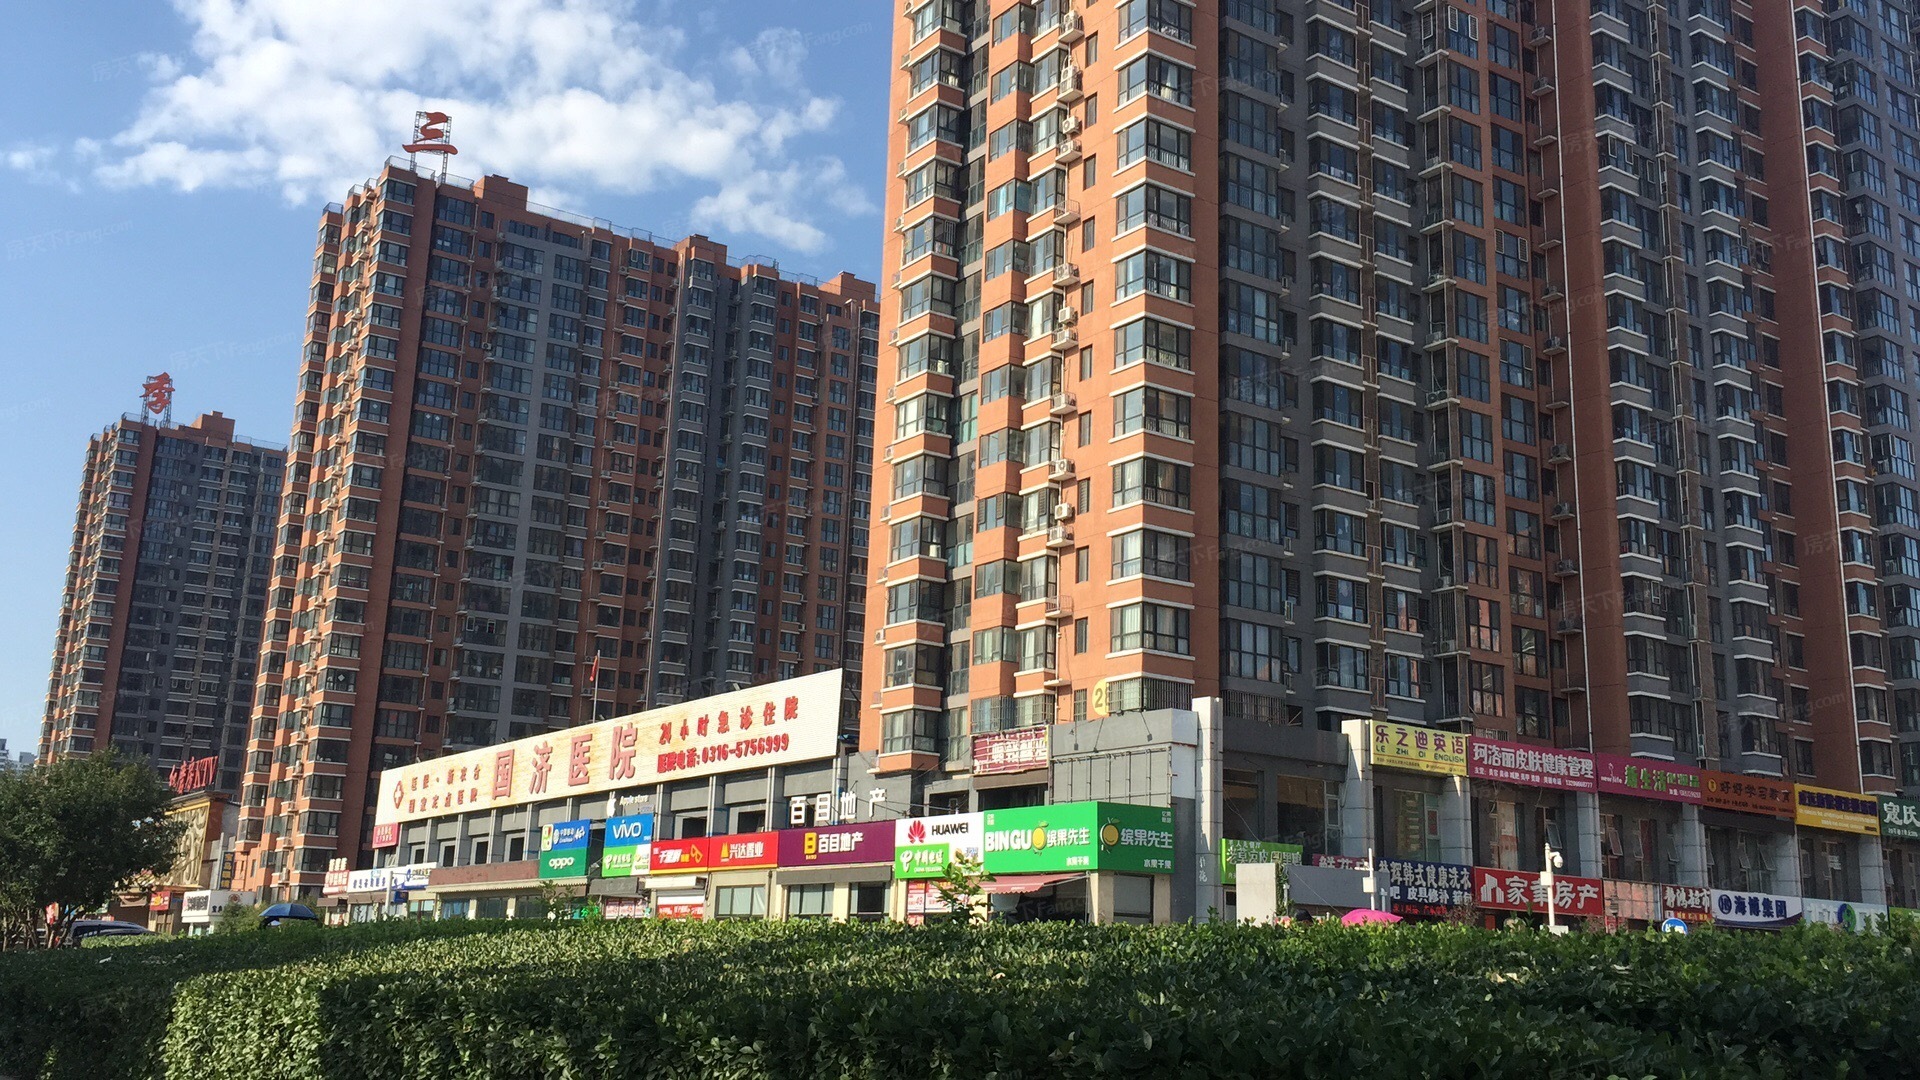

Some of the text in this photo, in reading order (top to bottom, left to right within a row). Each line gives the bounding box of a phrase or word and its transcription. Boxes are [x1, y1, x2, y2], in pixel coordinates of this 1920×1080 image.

[659, 695, 799, 745] 24小时急诊住院
[1375, 724, 1464, 755] 乐之迪英语
[492, 722, 638, 800] 国济医院
[1375, 744, 1386, 752] LE
[1396, 748, 1408, 756] ZHI
[1433, 752, 1464, 763] ENGLISH
[1473, 742, 1594, 779] 珂洛丽皮肤健康管理
[791, 788, 887, 824] 百目地产
[612, 819, 642, 839] vivo
[931, 822, 969, 836] HUAWEI
[1047, 827, 1090, 848] 缤果先生
[1121, 828, 1173, 849] 缤果先生
[729, 841, 764, 859] 兴达置业
[818, 832, 863, 853] 百目地产
[549, 857, 575, 869] oppo
[1733, 895, 1788, 919] 海博集团
